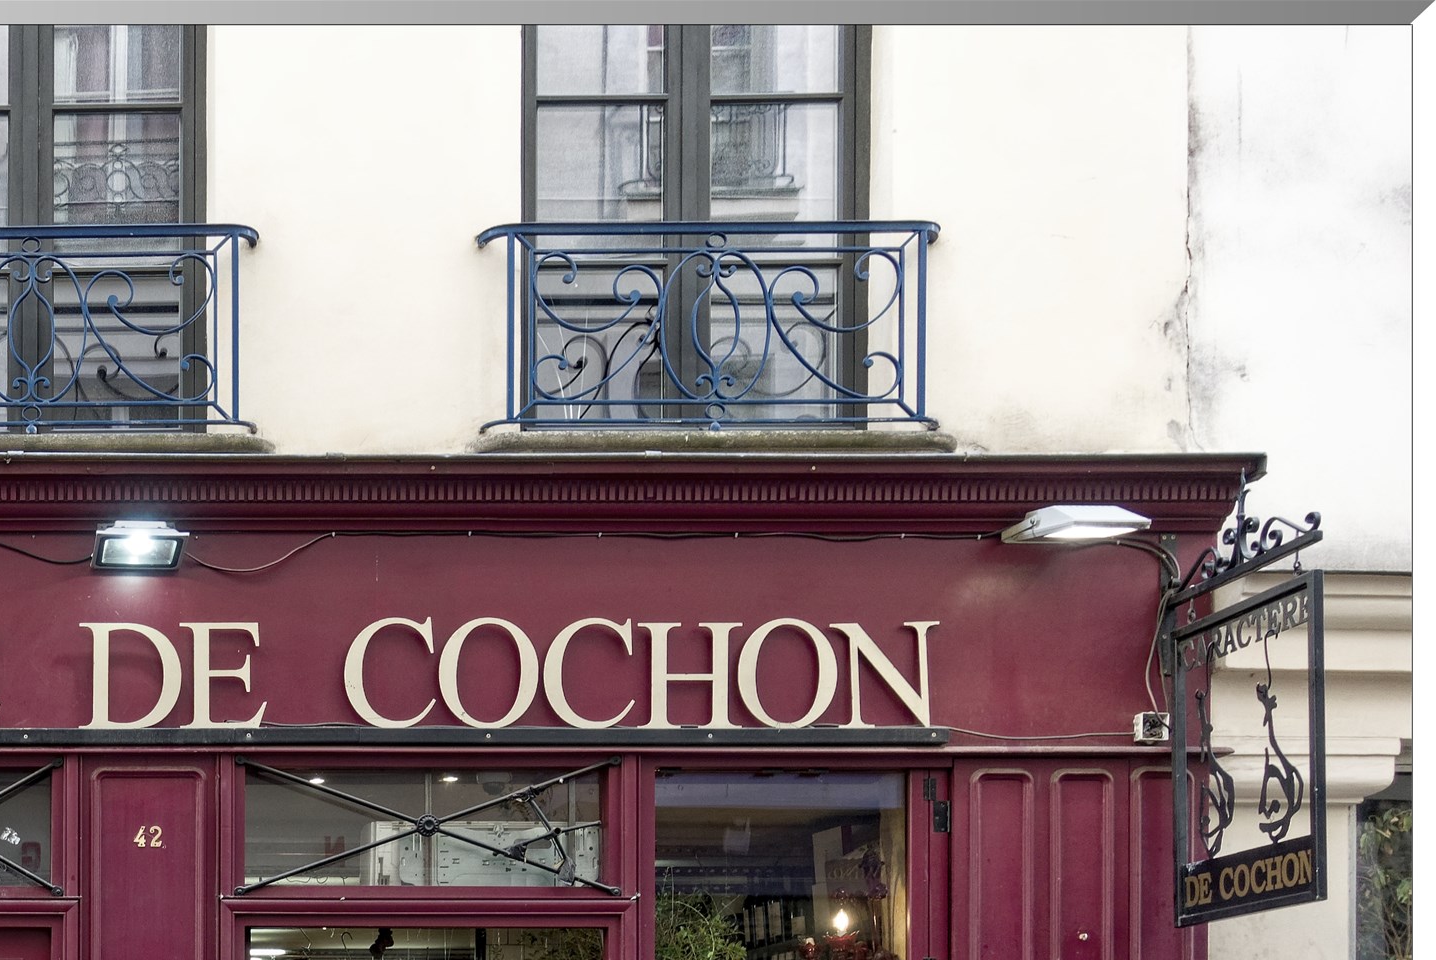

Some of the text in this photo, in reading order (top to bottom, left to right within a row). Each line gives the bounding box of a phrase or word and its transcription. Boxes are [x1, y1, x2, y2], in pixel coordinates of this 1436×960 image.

[79, 621, 268, 729] DE
[344, 616, 940, 730] COCHON
[132, 825, 164, 849] 42
[1185, 848, 1312, 908] DE COCHON
